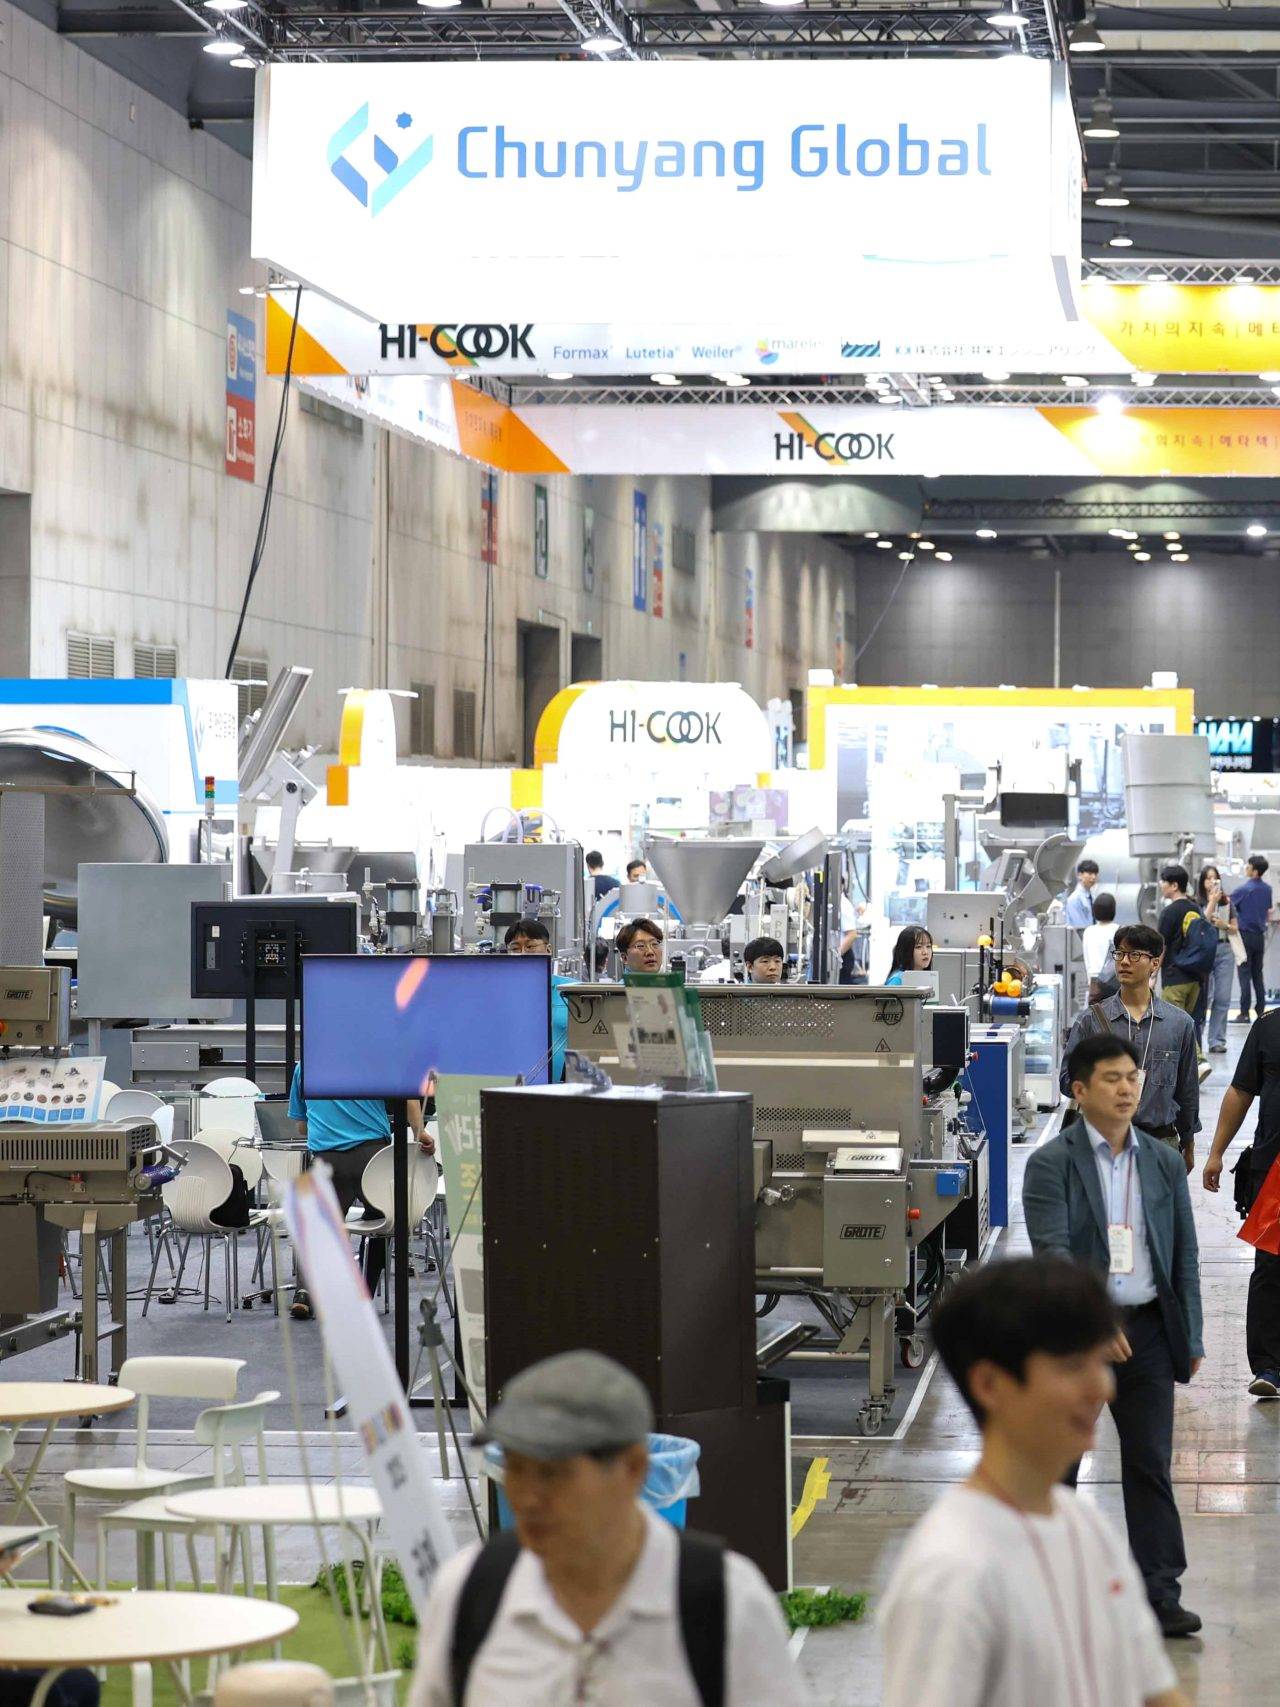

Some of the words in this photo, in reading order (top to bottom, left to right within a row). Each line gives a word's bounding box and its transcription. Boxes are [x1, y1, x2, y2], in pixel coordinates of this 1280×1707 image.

[457, 125, 765, 192] Chunyang
[790, 123, 992, 178] Global
[379, 323, 536, 360] HI-COOK
[553, 346, 609, 361] Formax
[626, 346, 675, 360] Lutetia
[692, 346, 737, 359] Weiler
[774, 432, 895, 461] HI-COOK
[609, 710, 722, 744] HI-COOK
[843, 1226, 881, 1238] GROTE
